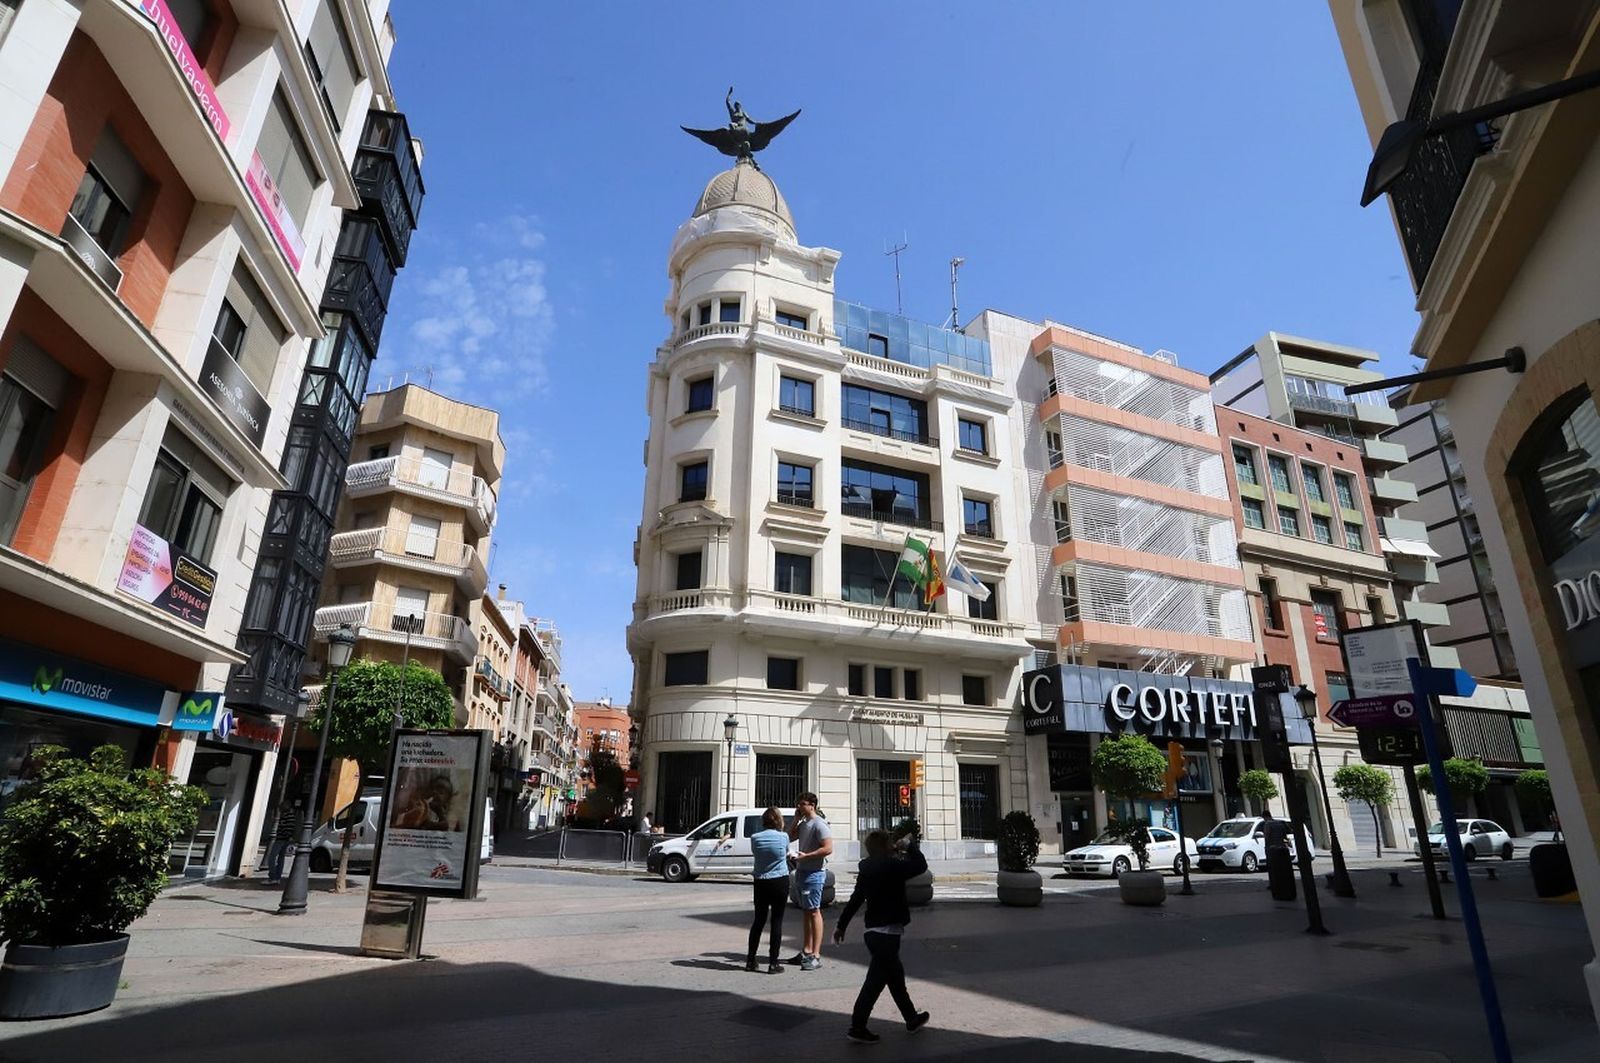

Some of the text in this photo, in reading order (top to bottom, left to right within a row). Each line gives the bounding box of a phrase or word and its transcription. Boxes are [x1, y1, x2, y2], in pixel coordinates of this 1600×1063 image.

[149, 0, 224, 134] huelvaderm
[61, 677, 113, 700] movistar
[1029, 674, 1052, 714] C
[1111, 683, 1258, 727] CORTEFI
[178, 717, 209, 726] movistar
[1025, 714, 1062, 728] CORTEFIEL
[1378, 735, 1419, 753] 12:1
